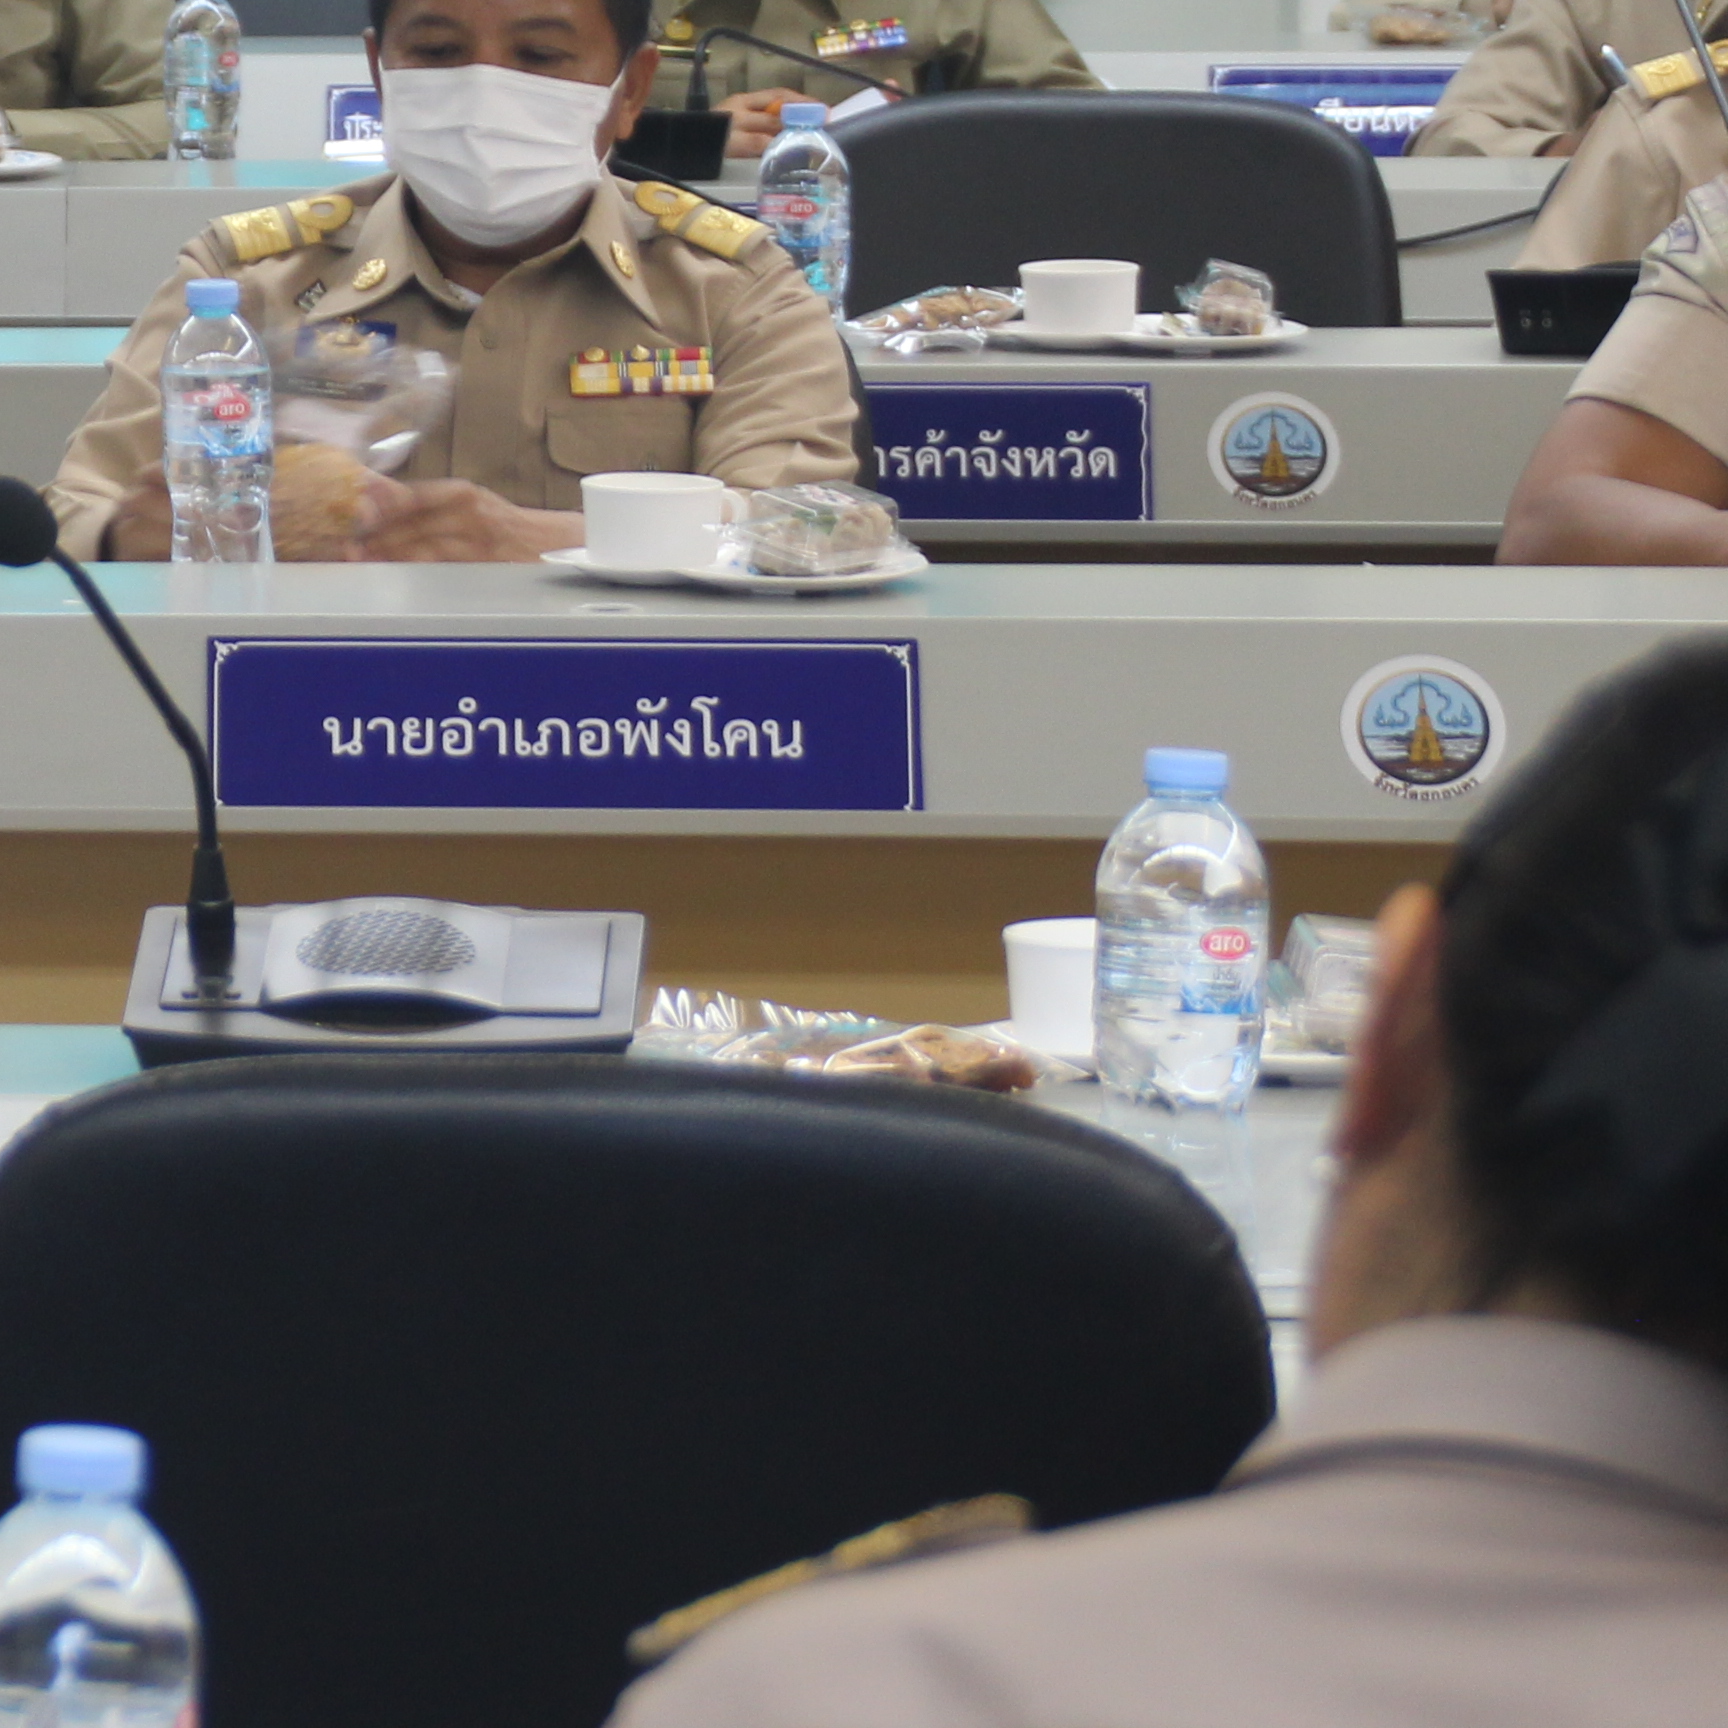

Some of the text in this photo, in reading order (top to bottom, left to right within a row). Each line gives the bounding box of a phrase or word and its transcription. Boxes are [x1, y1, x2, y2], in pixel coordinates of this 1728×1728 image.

[218, 402, 246, 417] aro
[322, 696, 804, 758] นายอำเภอพังโคน
[1208, 934, 1245, 953] aro
